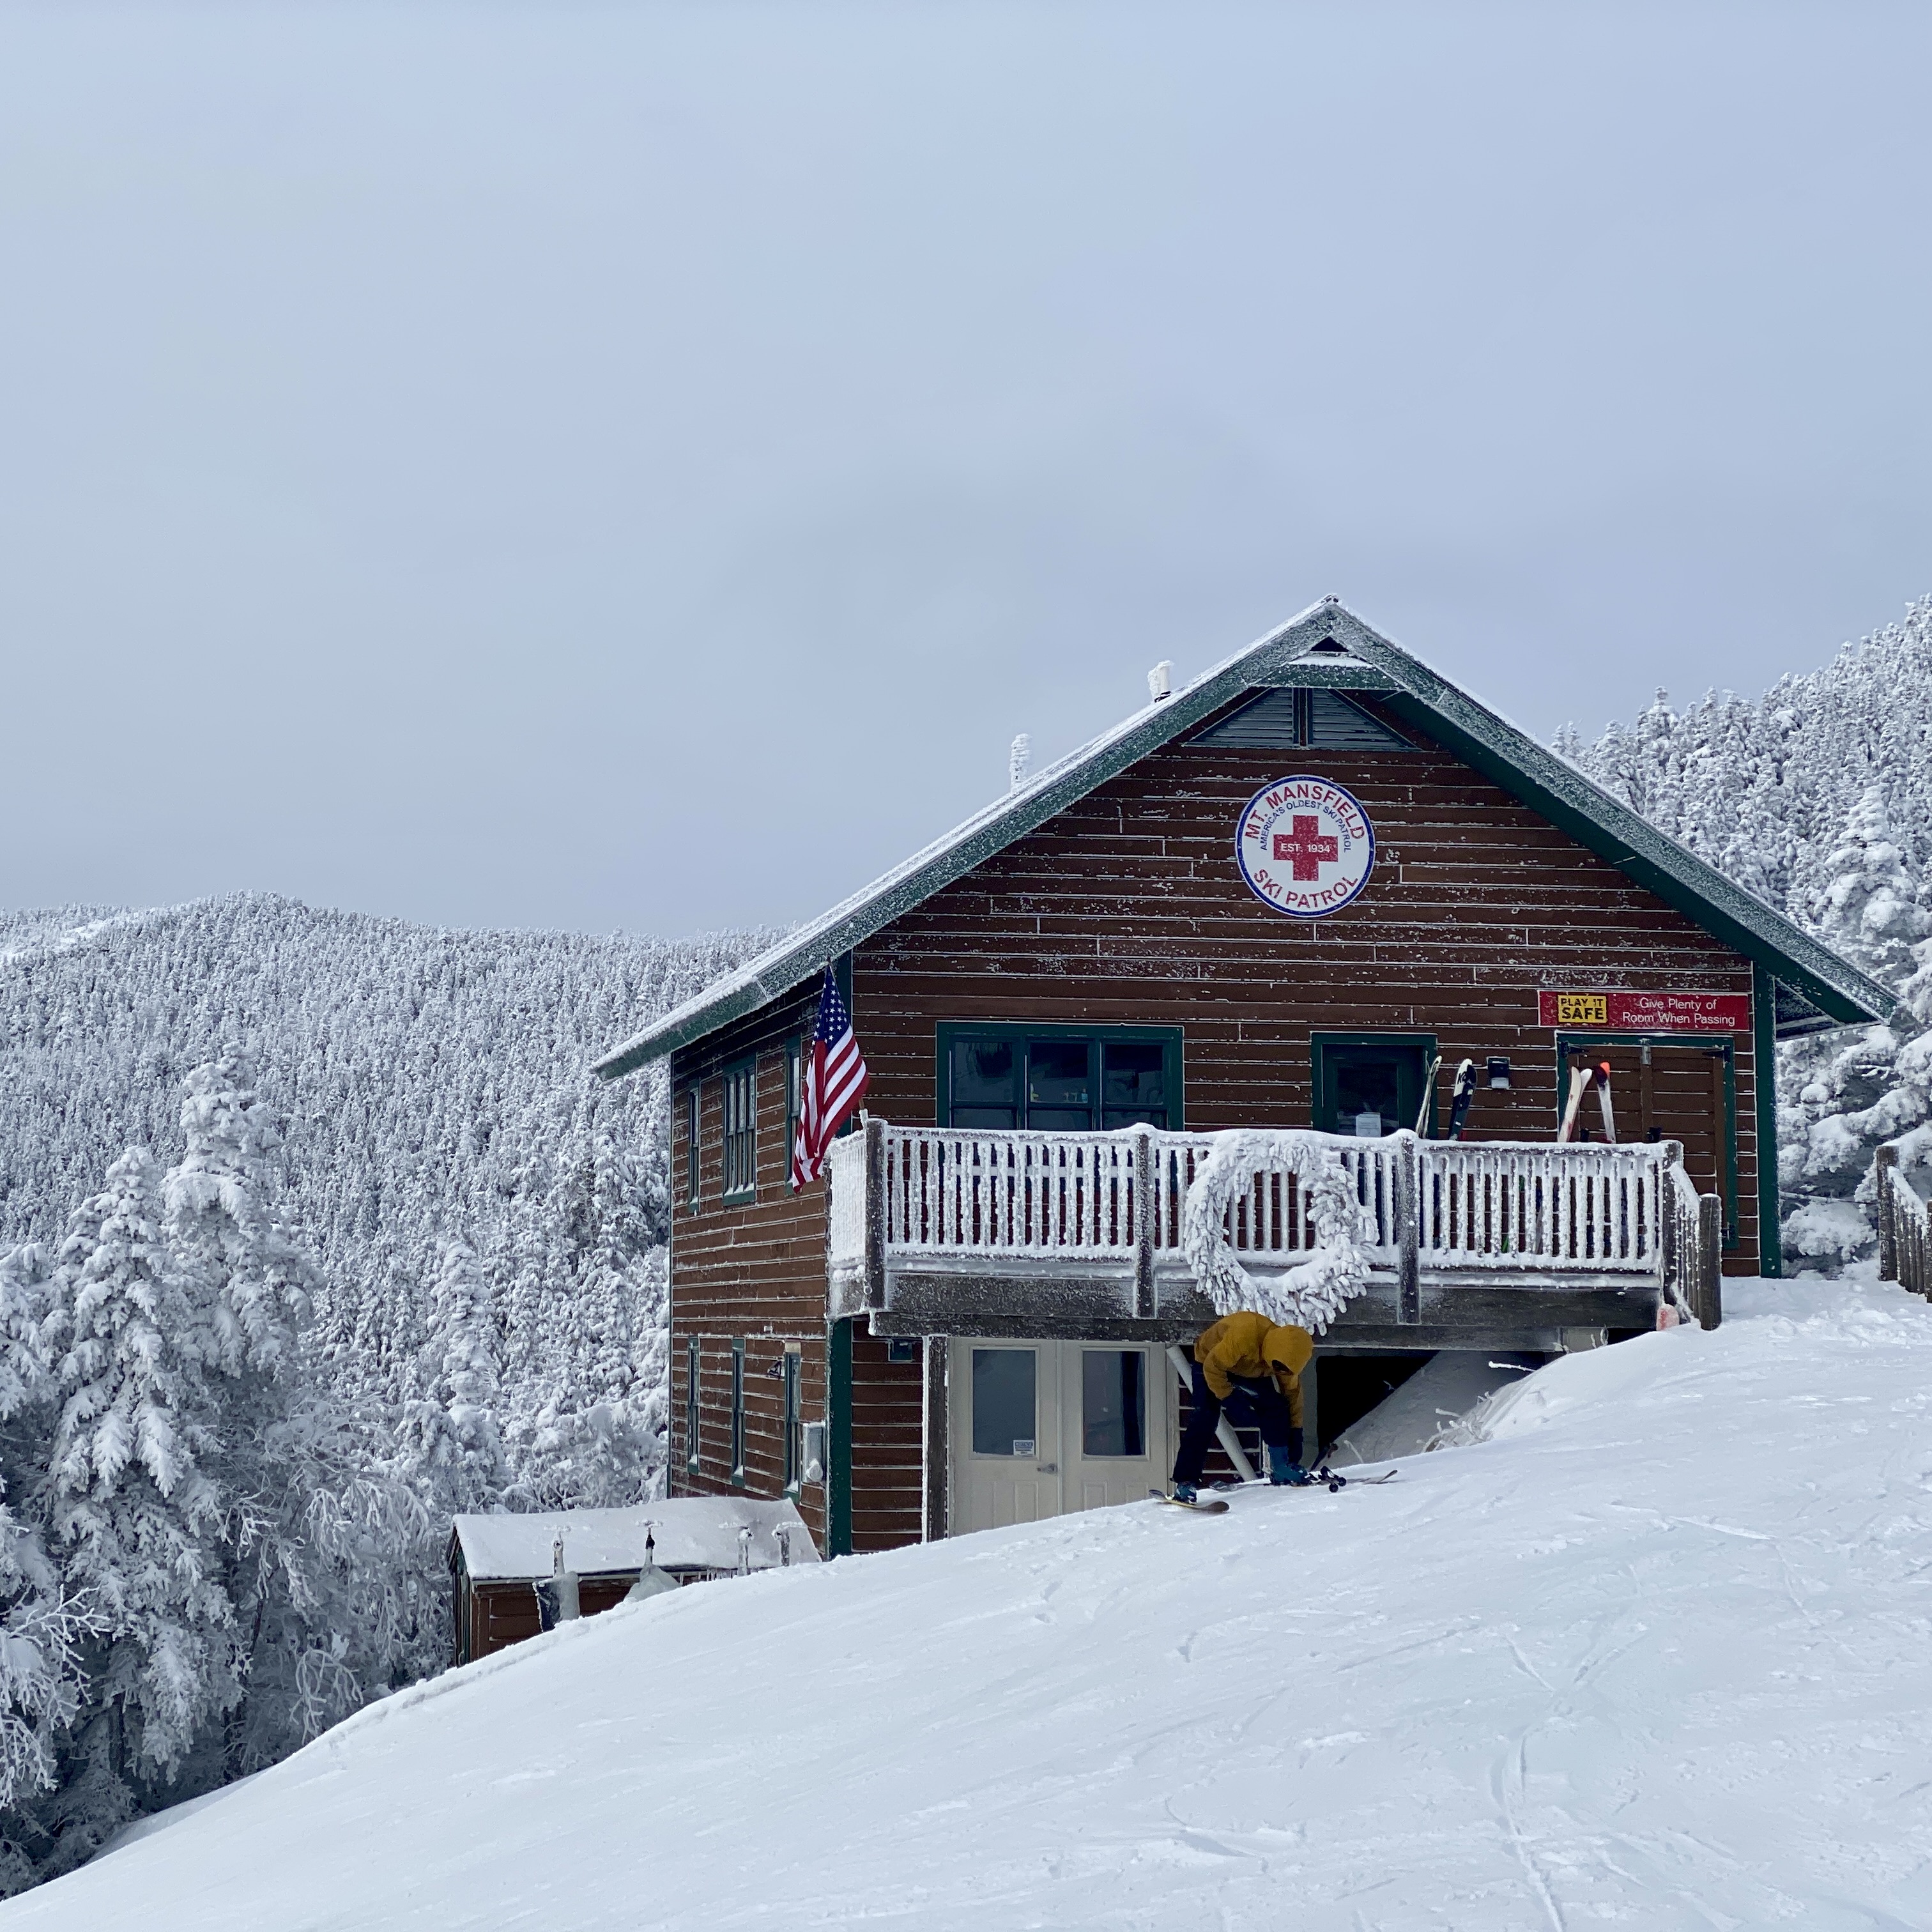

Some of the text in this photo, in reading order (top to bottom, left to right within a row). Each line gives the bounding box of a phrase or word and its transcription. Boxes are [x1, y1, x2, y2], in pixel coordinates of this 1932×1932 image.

[1245, 784, 1365, 839] MT. MANSFIELD
[1286, 800, 1322, 810] OLDEST
[1322, 806, 1338, 820] SKI
[1335, 818, 1351, 853] PATROL
[1307, 843, 1331, 853] 1934
[1254, 869, 1359, 908] SKI PATROL
[1561, 998, 1604, 1007] PLAY IT
[1639, 997, 1717, 1011] Give Plenty of
[1561, 1007, 1604, 1020] SAFE
[1623, 1011, 1735, 1027] Room When Passing
